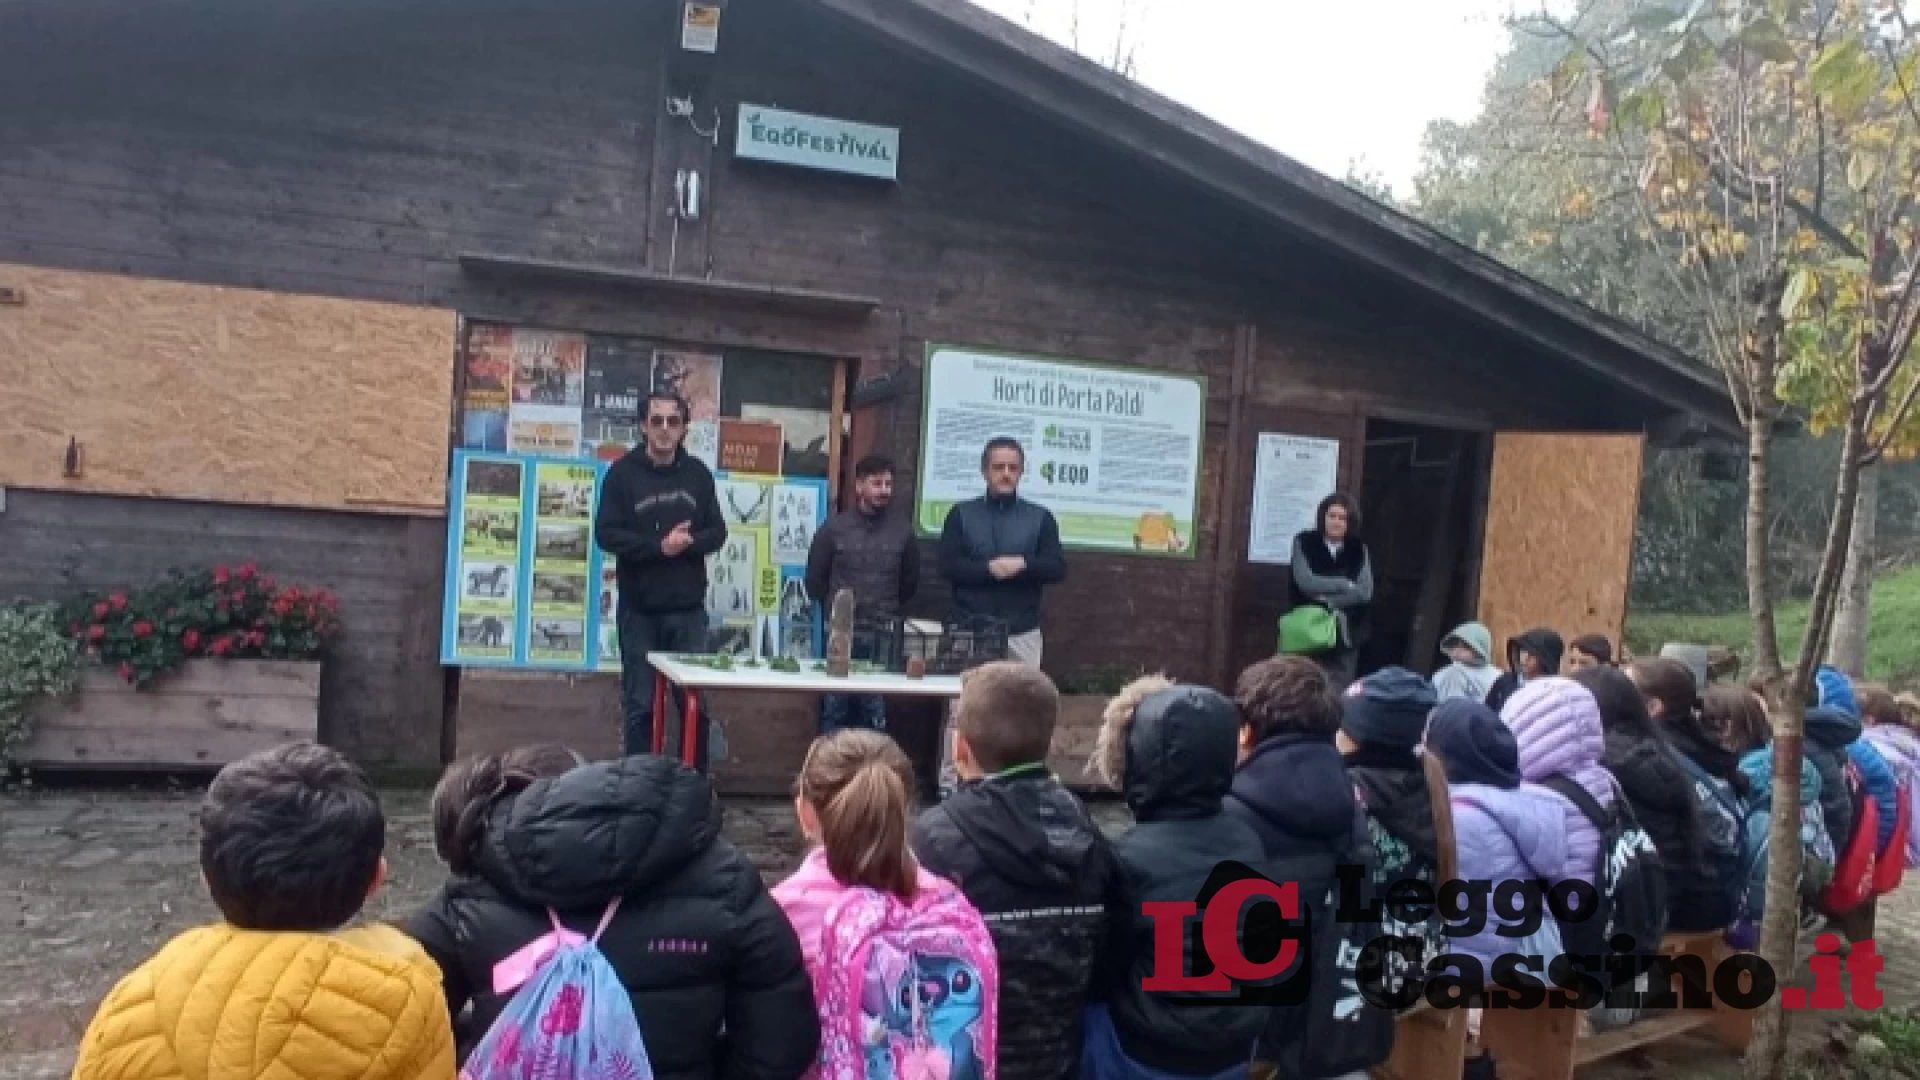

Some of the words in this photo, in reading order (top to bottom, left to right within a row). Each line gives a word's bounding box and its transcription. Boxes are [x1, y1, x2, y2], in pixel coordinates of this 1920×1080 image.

[993, 375, 1036, 406] Horti
[1039, 380, 1055, 407] di
[1058, 383, 1103, 412] Porta
